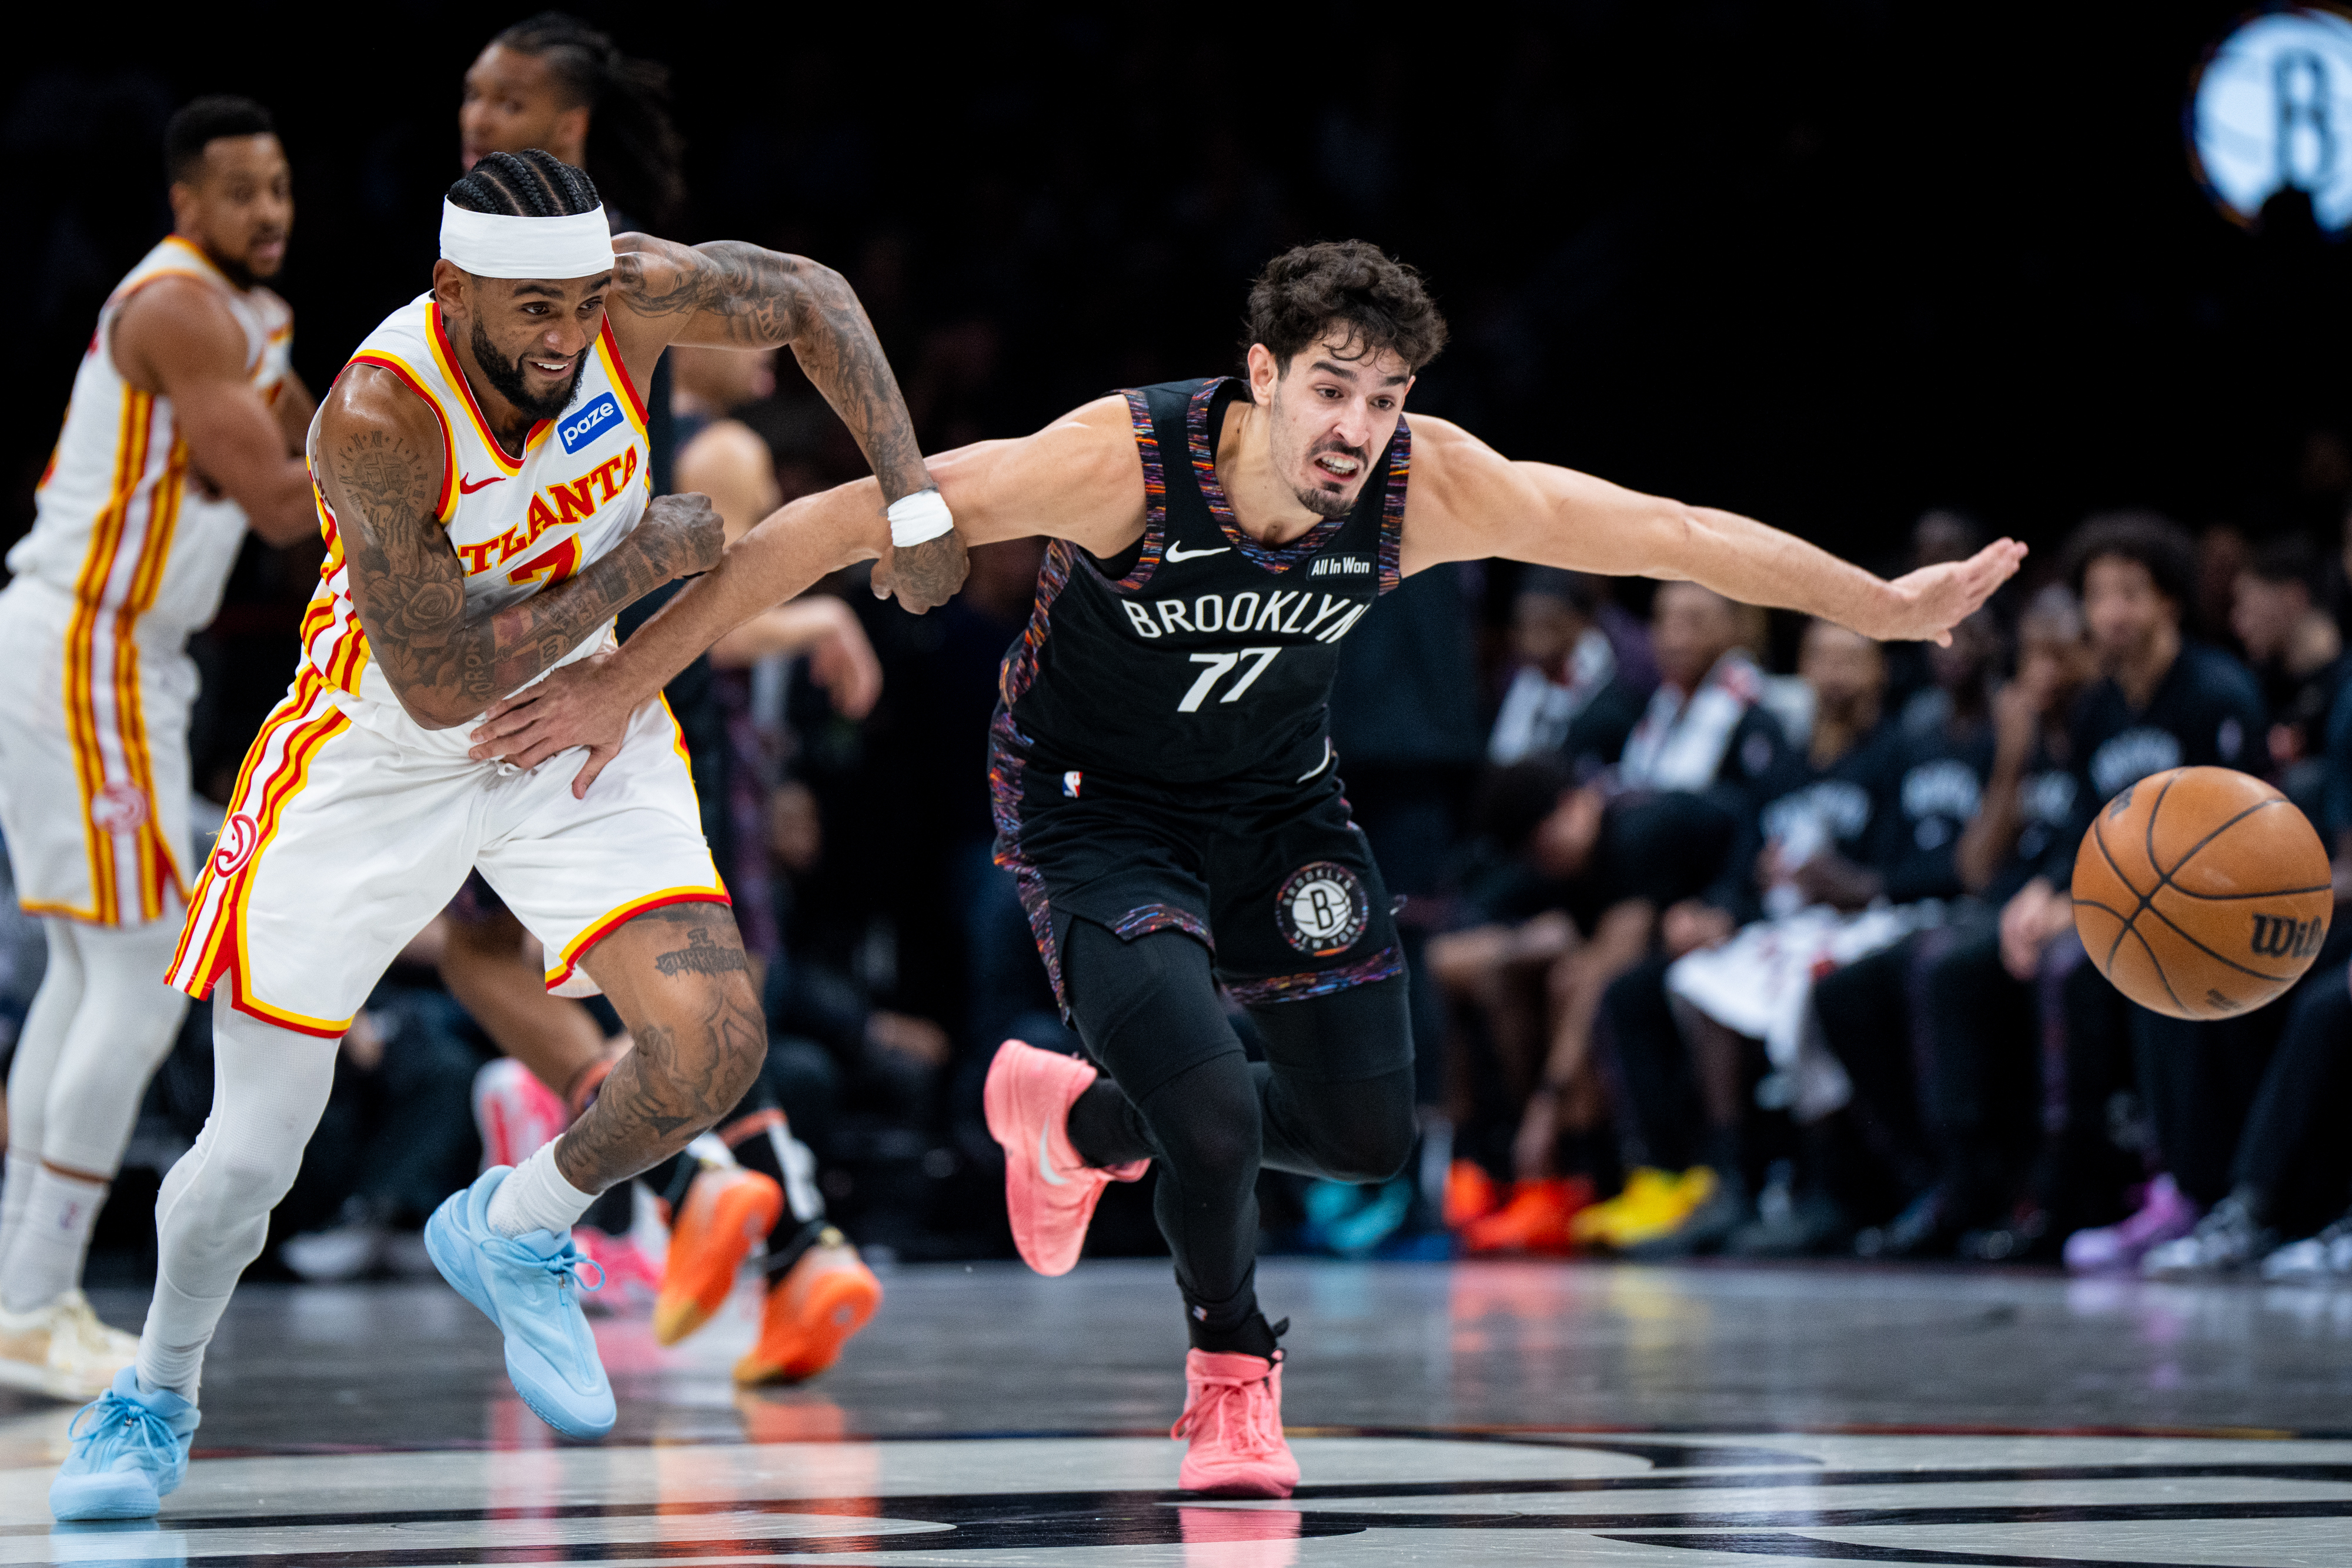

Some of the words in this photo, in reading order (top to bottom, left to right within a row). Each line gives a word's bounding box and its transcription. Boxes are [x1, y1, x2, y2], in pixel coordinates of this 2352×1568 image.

[563, 403, 614, 446] paze
[457, 442, 638, 578] TLANTA
[1311, 559, 1328, 576] All
[1329, 558, 1341, 574] In
[1343, 557, 1370, 574] Won
[1122, 591, 1371, 644] BROOKLYN
[1177, 647, 1282, 712] 77
[1311, 890, 1334, 930] B
[2251, 912, 2324, 959] Wil
